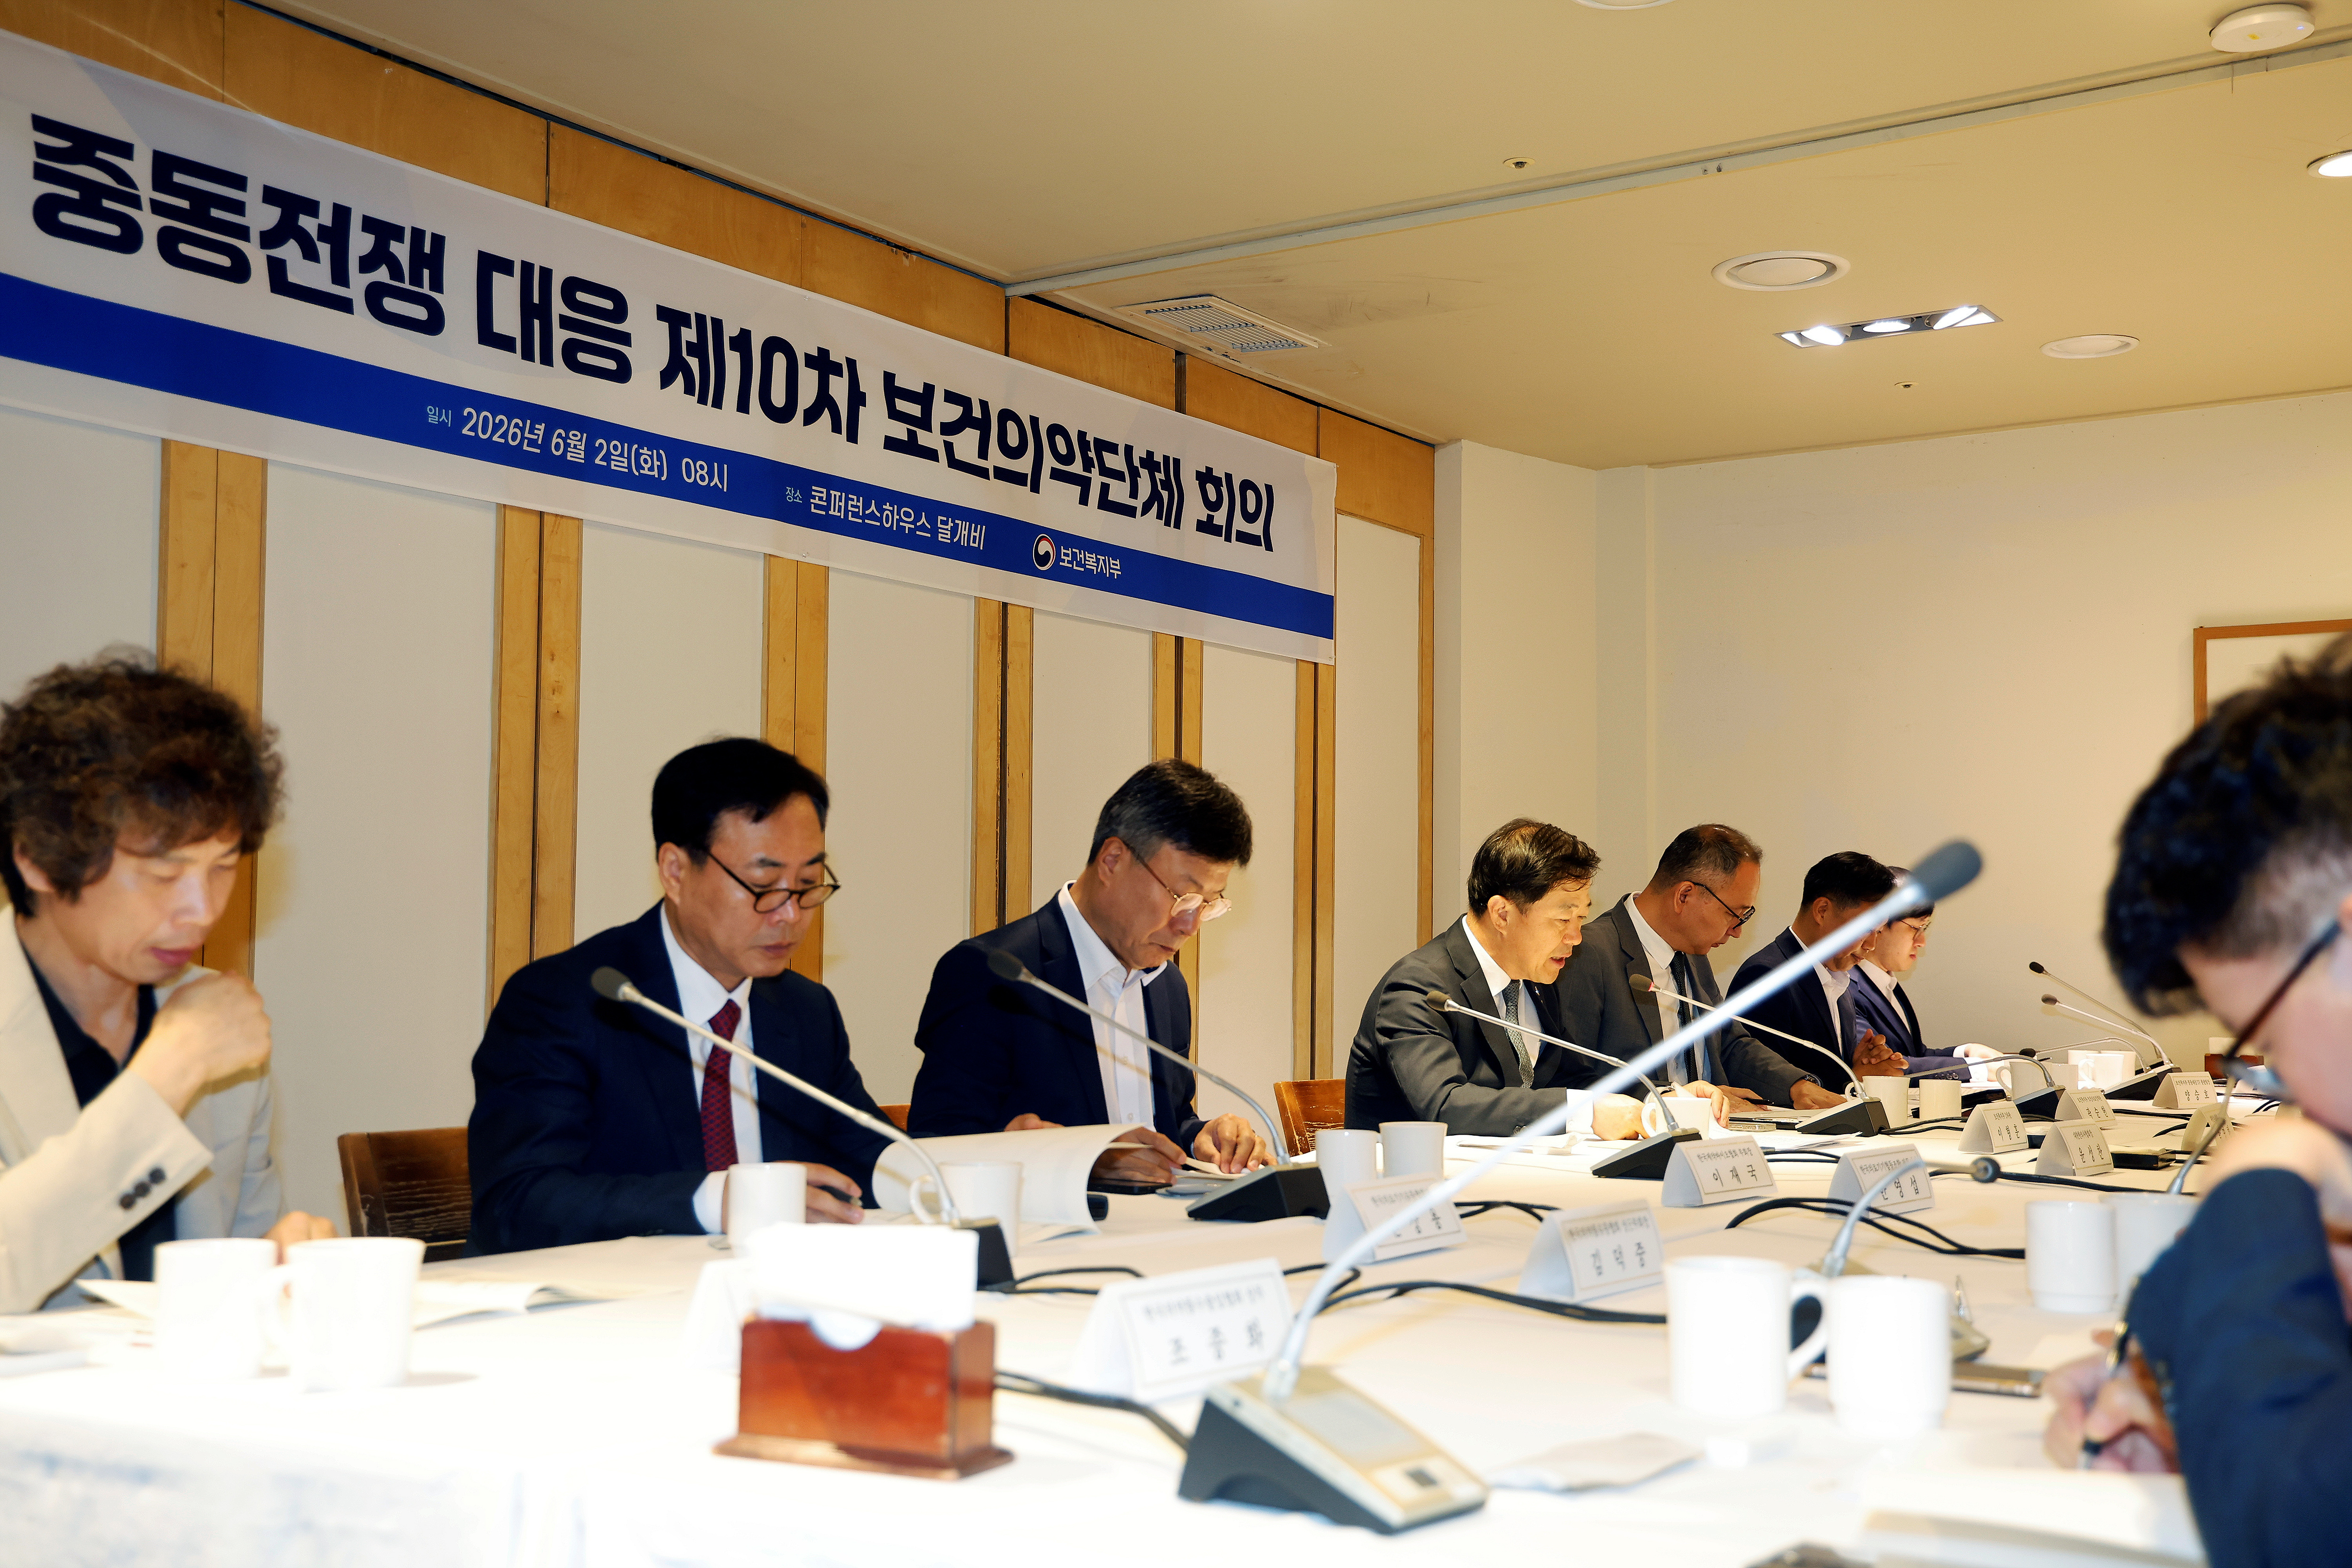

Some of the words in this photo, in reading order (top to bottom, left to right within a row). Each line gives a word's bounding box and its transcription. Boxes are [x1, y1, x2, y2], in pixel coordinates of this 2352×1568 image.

[31, 113, 445, 336] 중동전쟁
[476, 249, 632, 384] 대응
[656, 304, 866, 445] 제10차
[883, 370, 1184, 530] 보건의약단체
[1195, 465, 1274, 552] 회의
[427, 406, 452, 427] 일시
[462, 407, 546, 454] 2026년
[551, 429, 588, 463] 6월
[594, 438, 667, 481] 2일(화)
[682, 457, 728, 492] 08시
[785, 486, 803, 503] 장소
[810, 485, 932, 539] 콘퍼런스하우스
[938, 516, 986, 550] 달개비
[1059, 546, 1122, 579] 보건복지부
[2185, 1090, 2209, 1101] 양승호
[1713, 1164, 1758, 1187] 이재국
